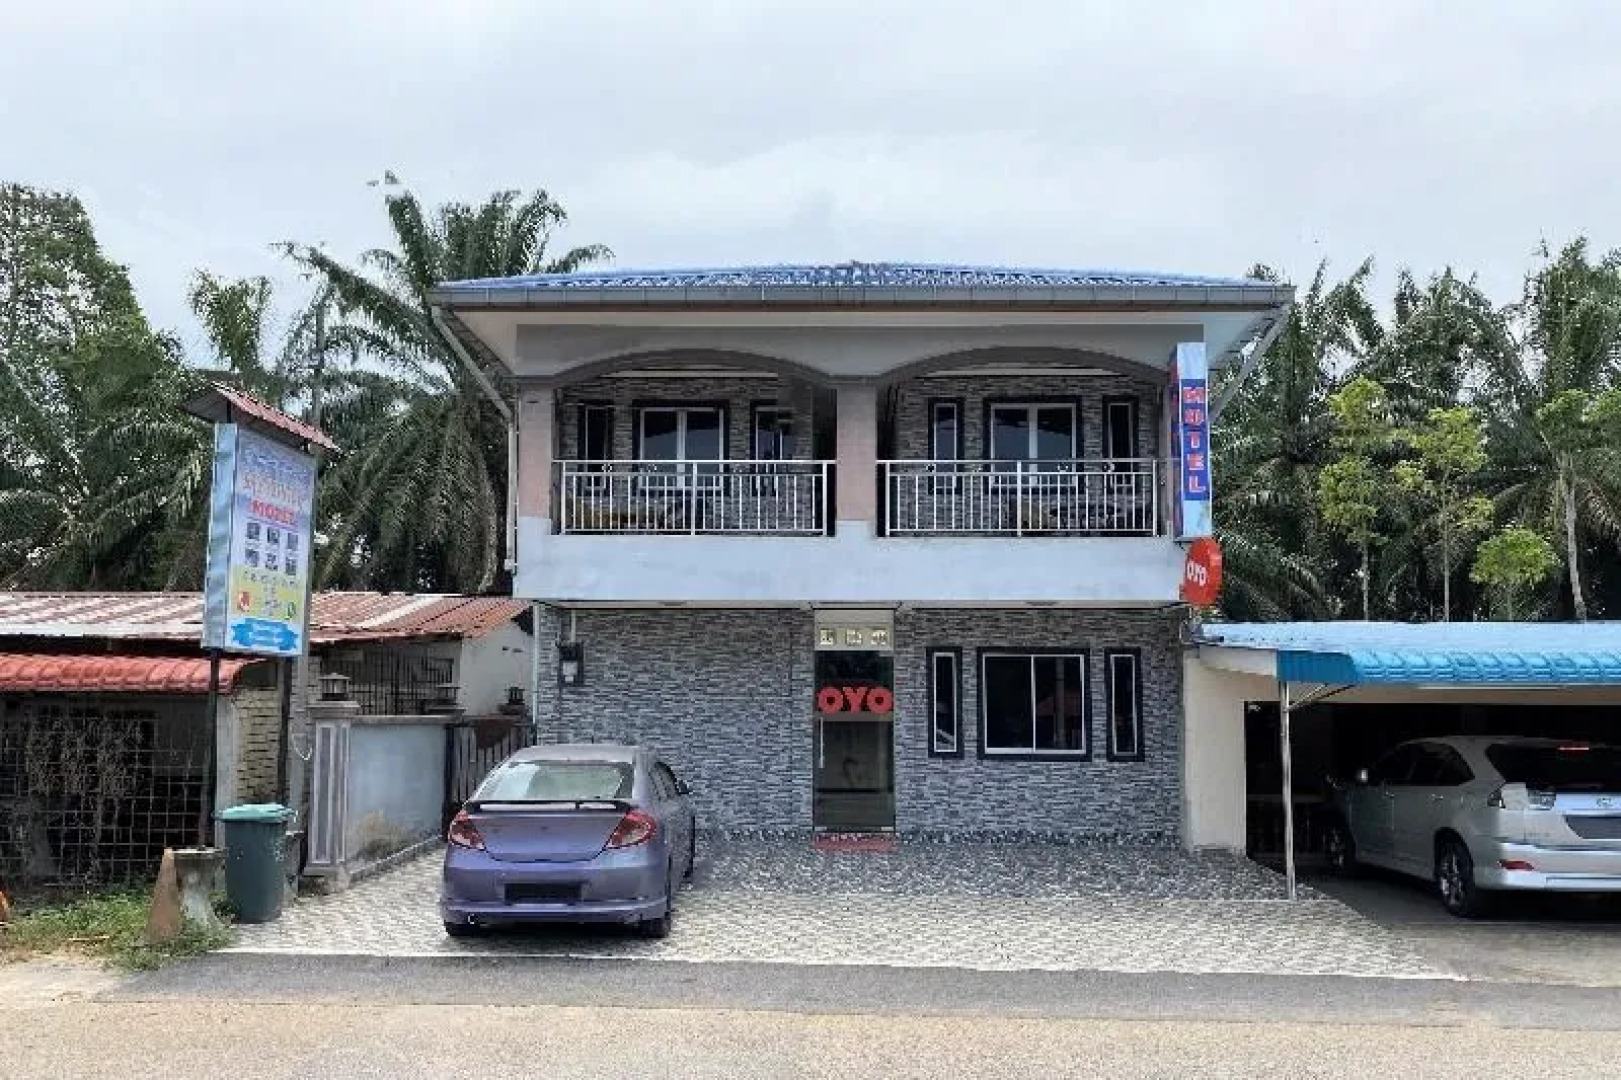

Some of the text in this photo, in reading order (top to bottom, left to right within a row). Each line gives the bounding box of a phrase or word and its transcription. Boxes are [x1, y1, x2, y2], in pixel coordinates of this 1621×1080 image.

[1182, 386, 1206, 493] MOTEL
[1187, 560, 1207, 586] OYO
[818, 686, 892, 715] OYO
